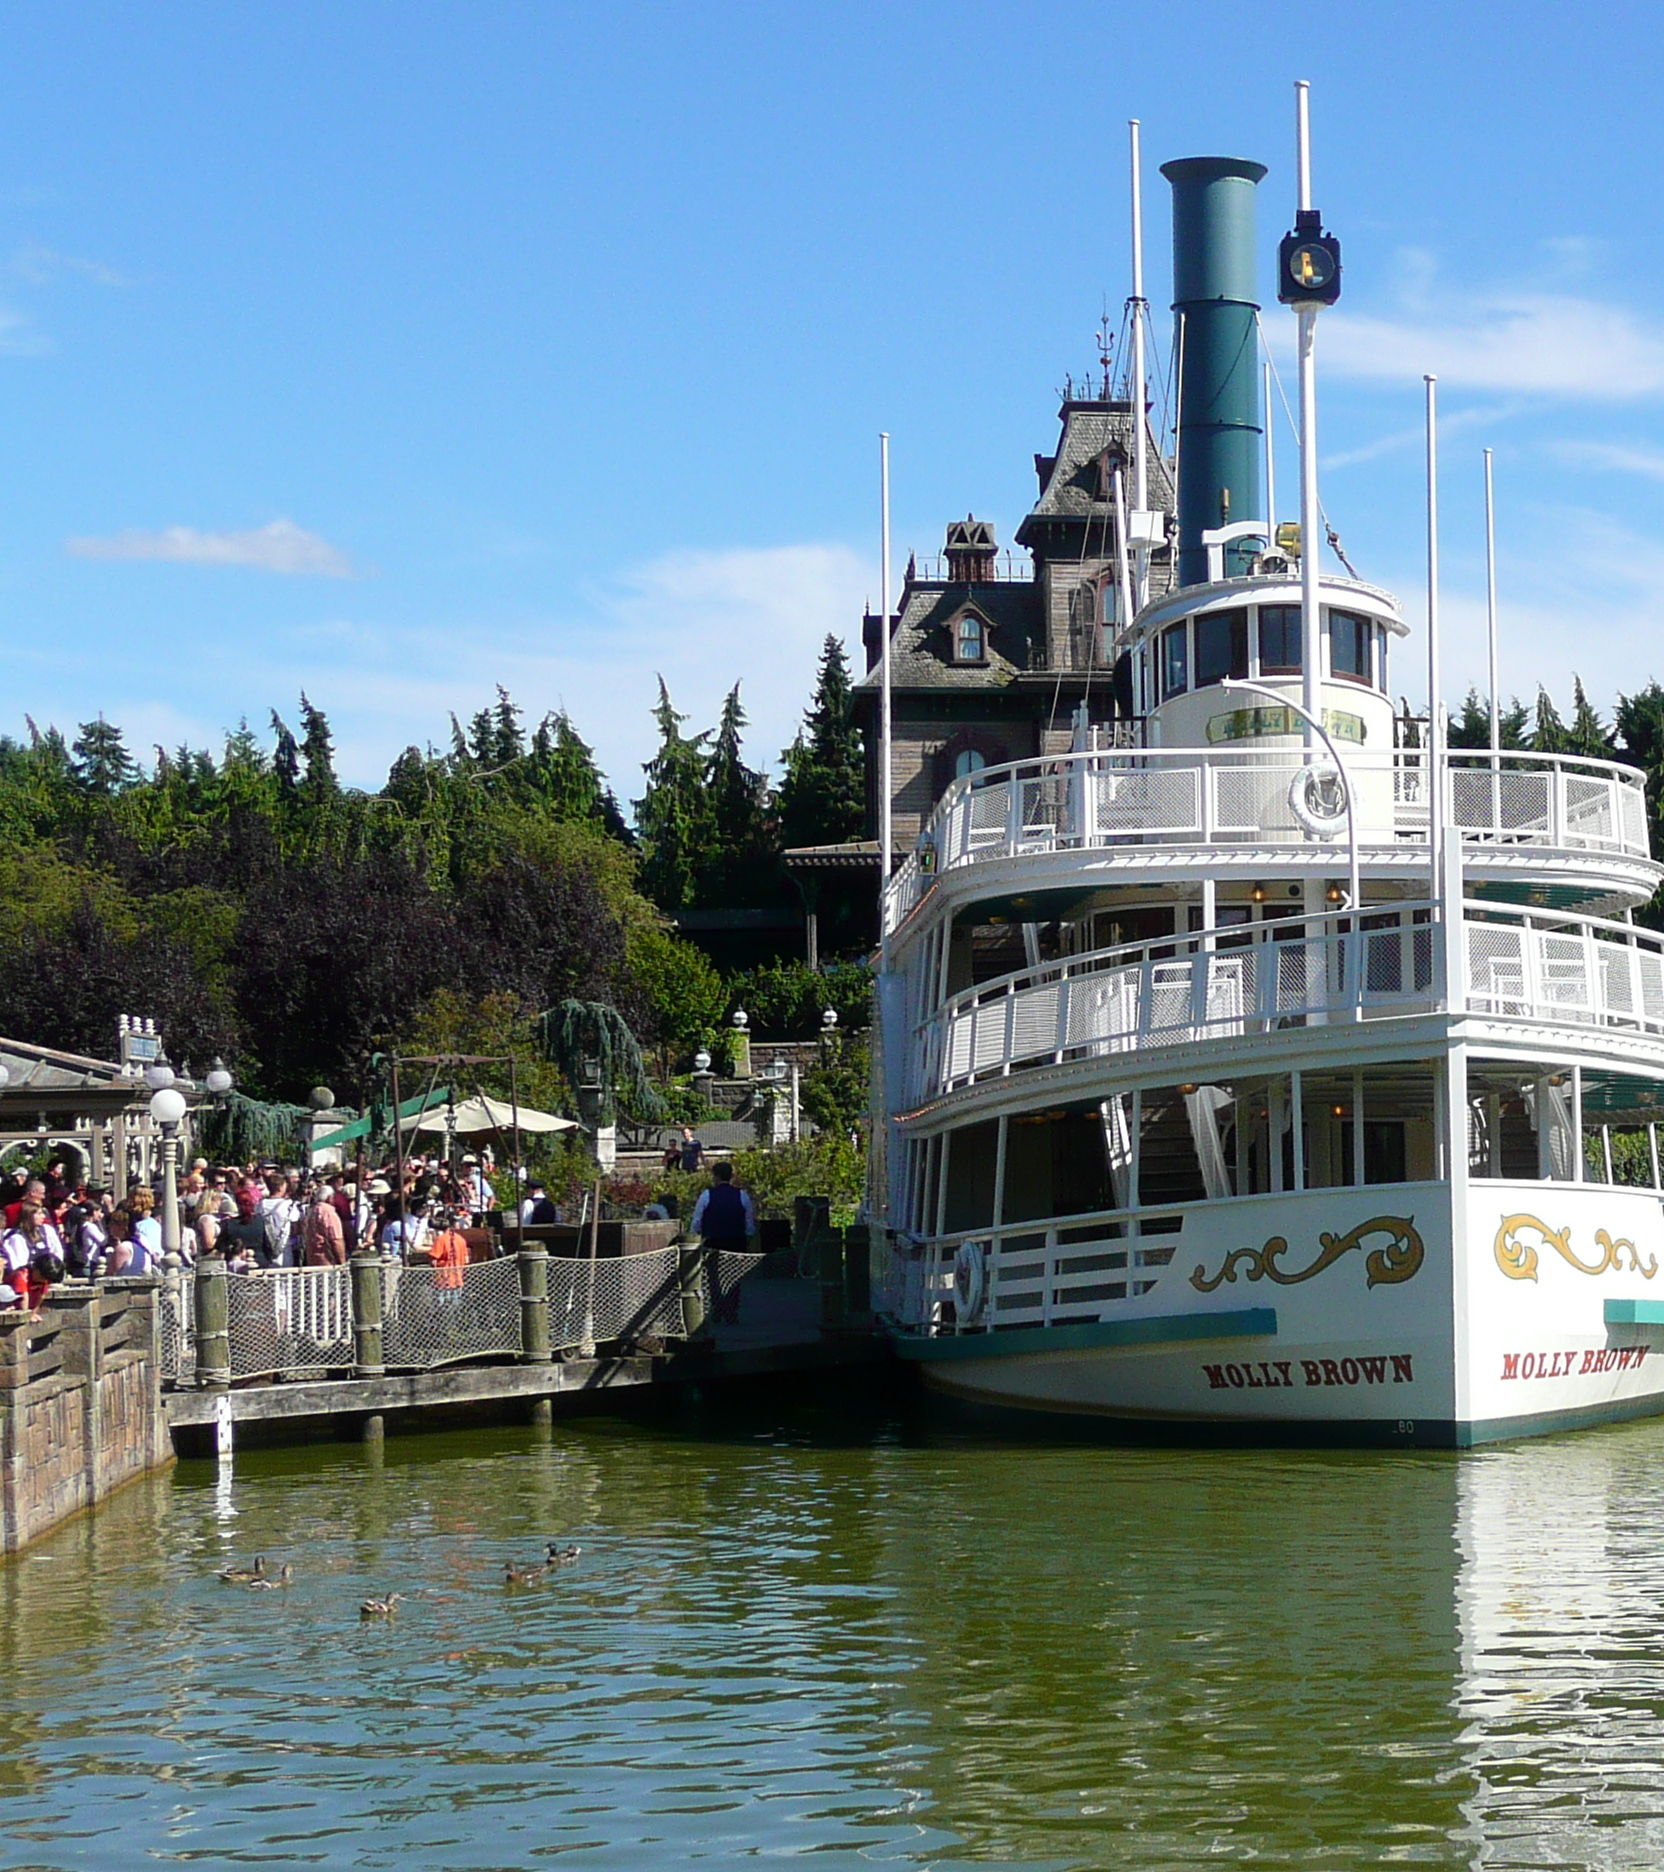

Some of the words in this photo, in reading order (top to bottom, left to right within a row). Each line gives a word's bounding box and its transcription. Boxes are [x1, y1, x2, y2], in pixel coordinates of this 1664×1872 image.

[1202, 1361, 1293, 1389] MOLLY
[1300, 1354, 1414, 1386] BROWN
[1500, 1351, 1577, 1380] MOLLY
[1578, 1345, 1650, 1375] BROWN
